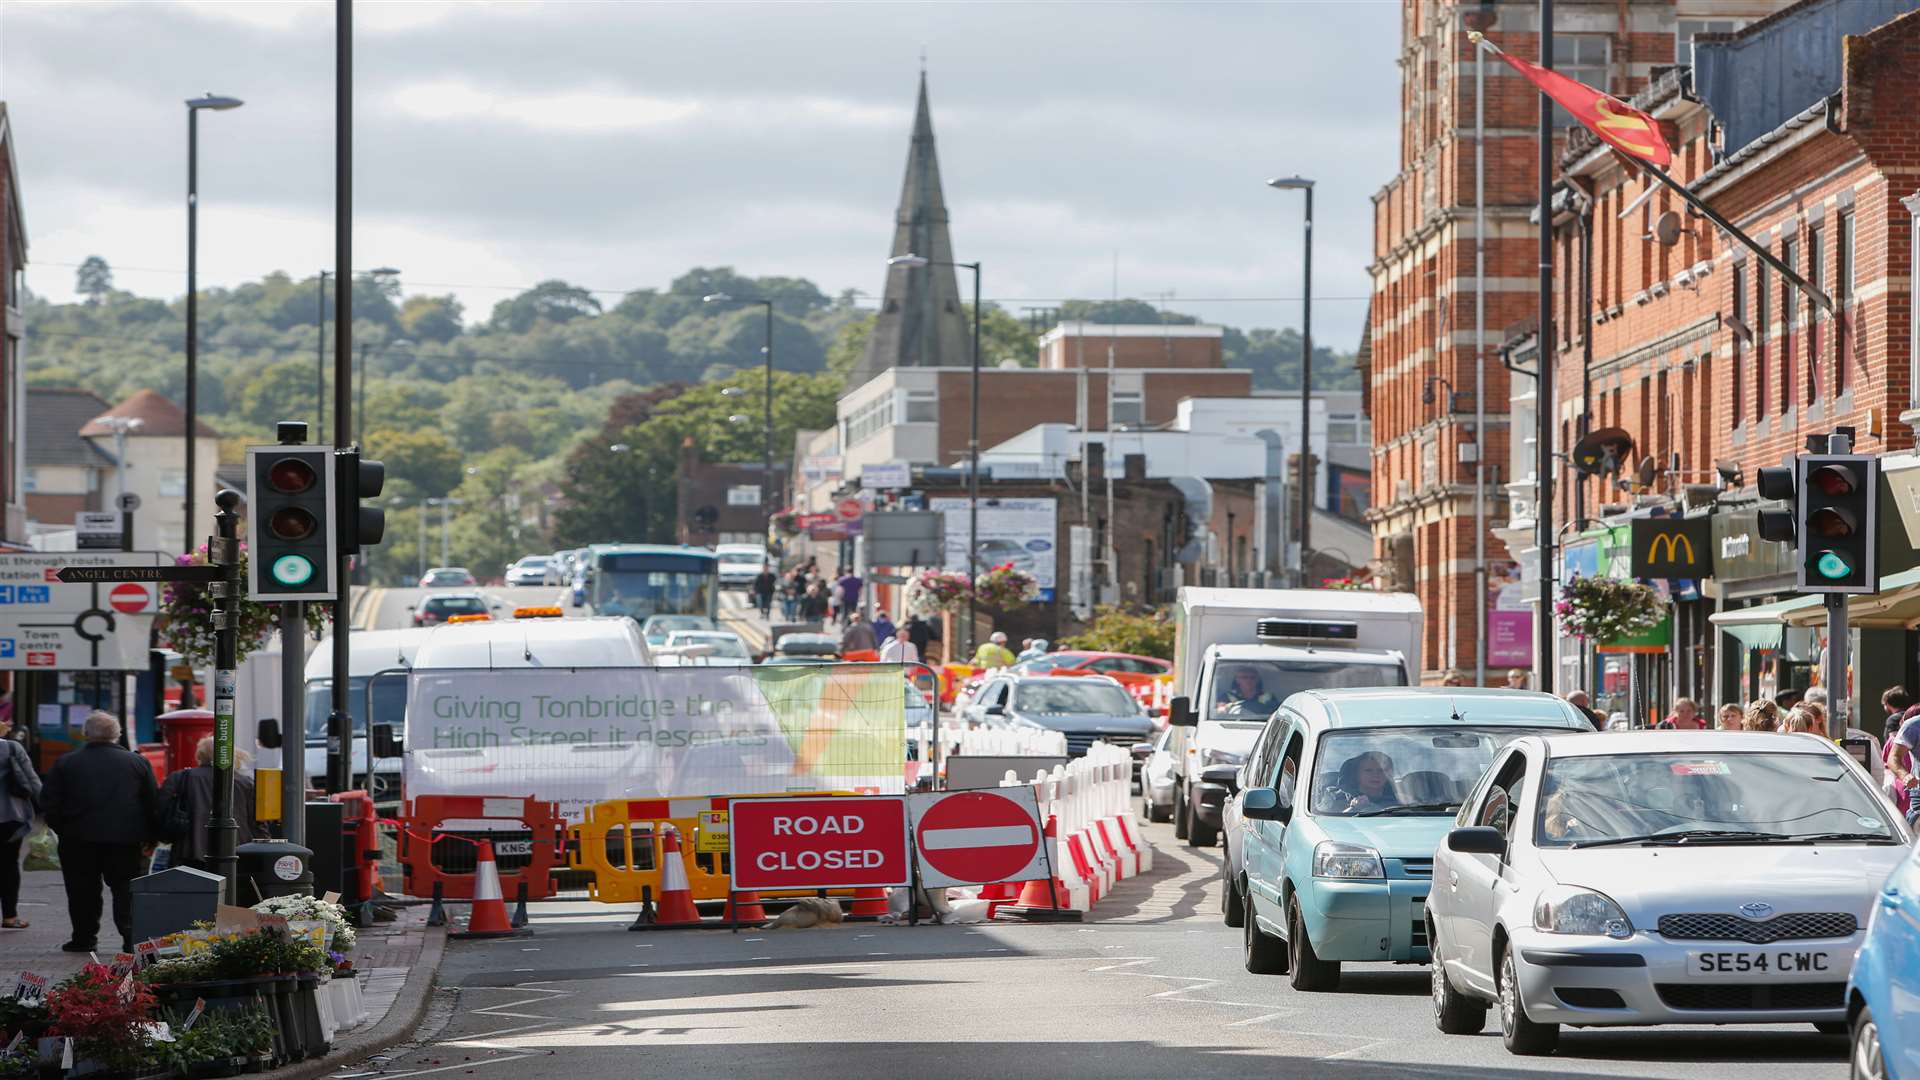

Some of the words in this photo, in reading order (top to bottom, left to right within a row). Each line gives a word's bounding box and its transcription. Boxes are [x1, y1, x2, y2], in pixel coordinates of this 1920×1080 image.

[13, 557, 65, 567] through
[71, 557, 115, 565] routes
[0, 569, 40, 580] tation
[68, 569, 110, 579] ANGEL
[113, 568, 162, 579] CENTRE
[19, 640, 63, 650] centre
[24, 630, 59, 640] Town
[433, 695, 521, 724] Giving
[531, 694, 675, 722] Tonbridge
[686, 694, 734, 718] the
[218, 719, 228, 741] butts
[433, 726, 499, 753] High
[510, 726, 599, 746] Street
[609, 725, 627, 749] it
[636, 724, 769, 748] deserves
[219, 745, 229, 765] gum
[773, 815, 865, 836] ROAD
[756, 849, 885, 871] CLOSED
[1699, 952, 1769, 973] SE54
[1777, 952, 1829, 972] CWC
